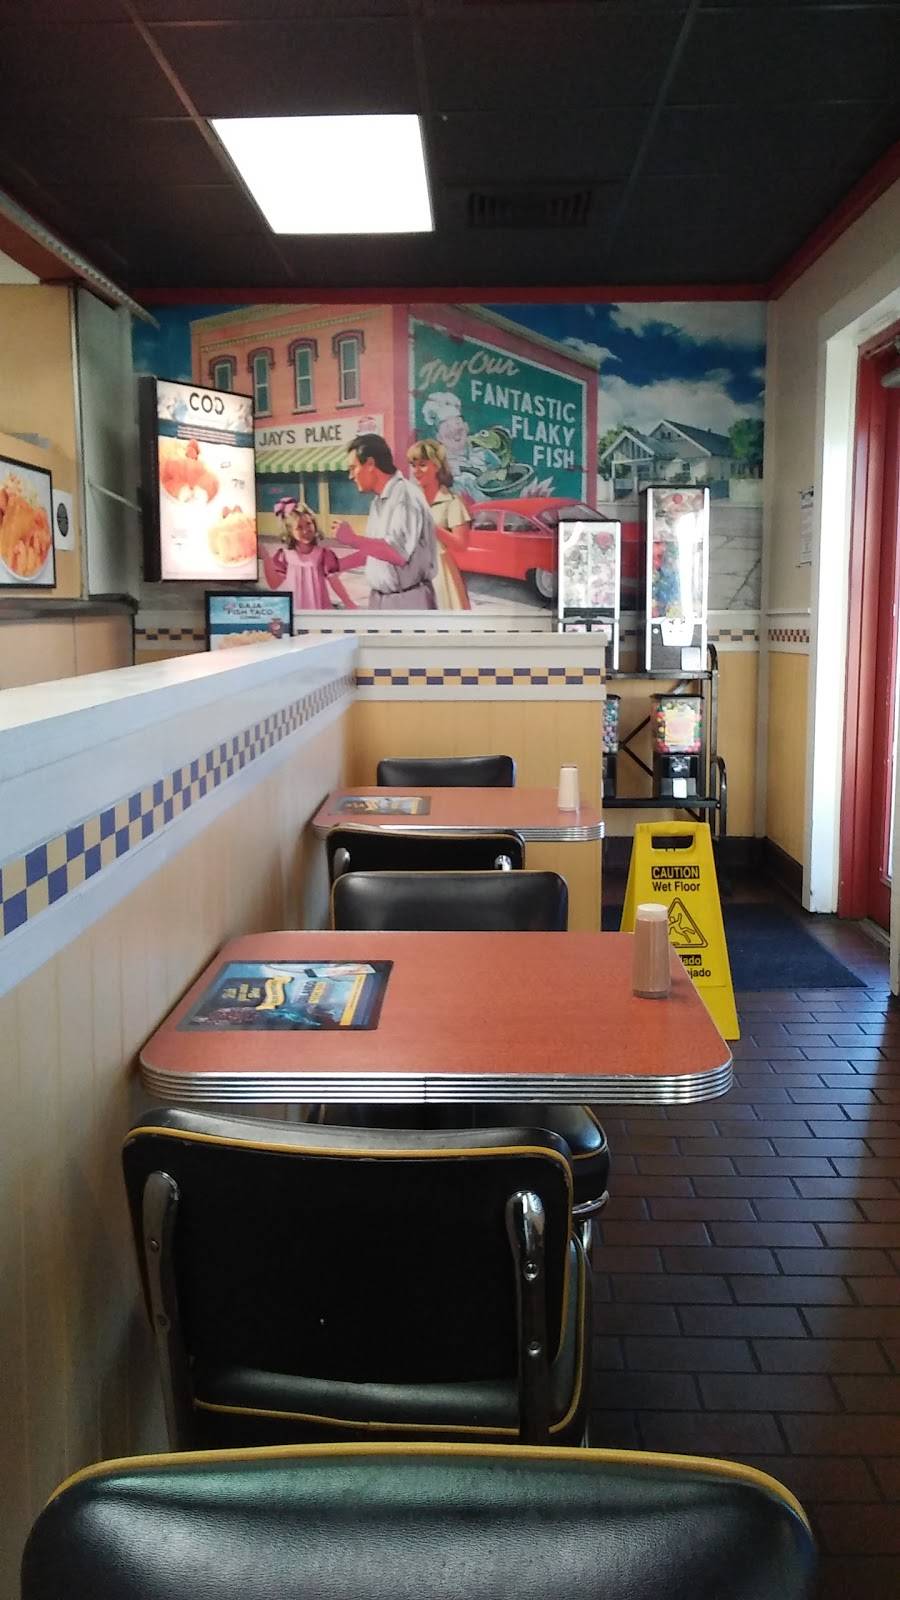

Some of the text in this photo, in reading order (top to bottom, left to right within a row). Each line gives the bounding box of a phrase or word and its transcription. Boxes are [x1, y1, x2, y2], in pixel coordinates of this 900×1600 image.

[467, 352, 520, 376] Our
[471, 379, 576, 424] FANTASTIC
[305, 424, 342, 443] PLACE
[511, 414, 575, 447] FLAKY
[532, 445, 575, 469] FISH
[652, 866, 699, 879] CAUTION
[652, 881, 701, 892] Wet Floor
